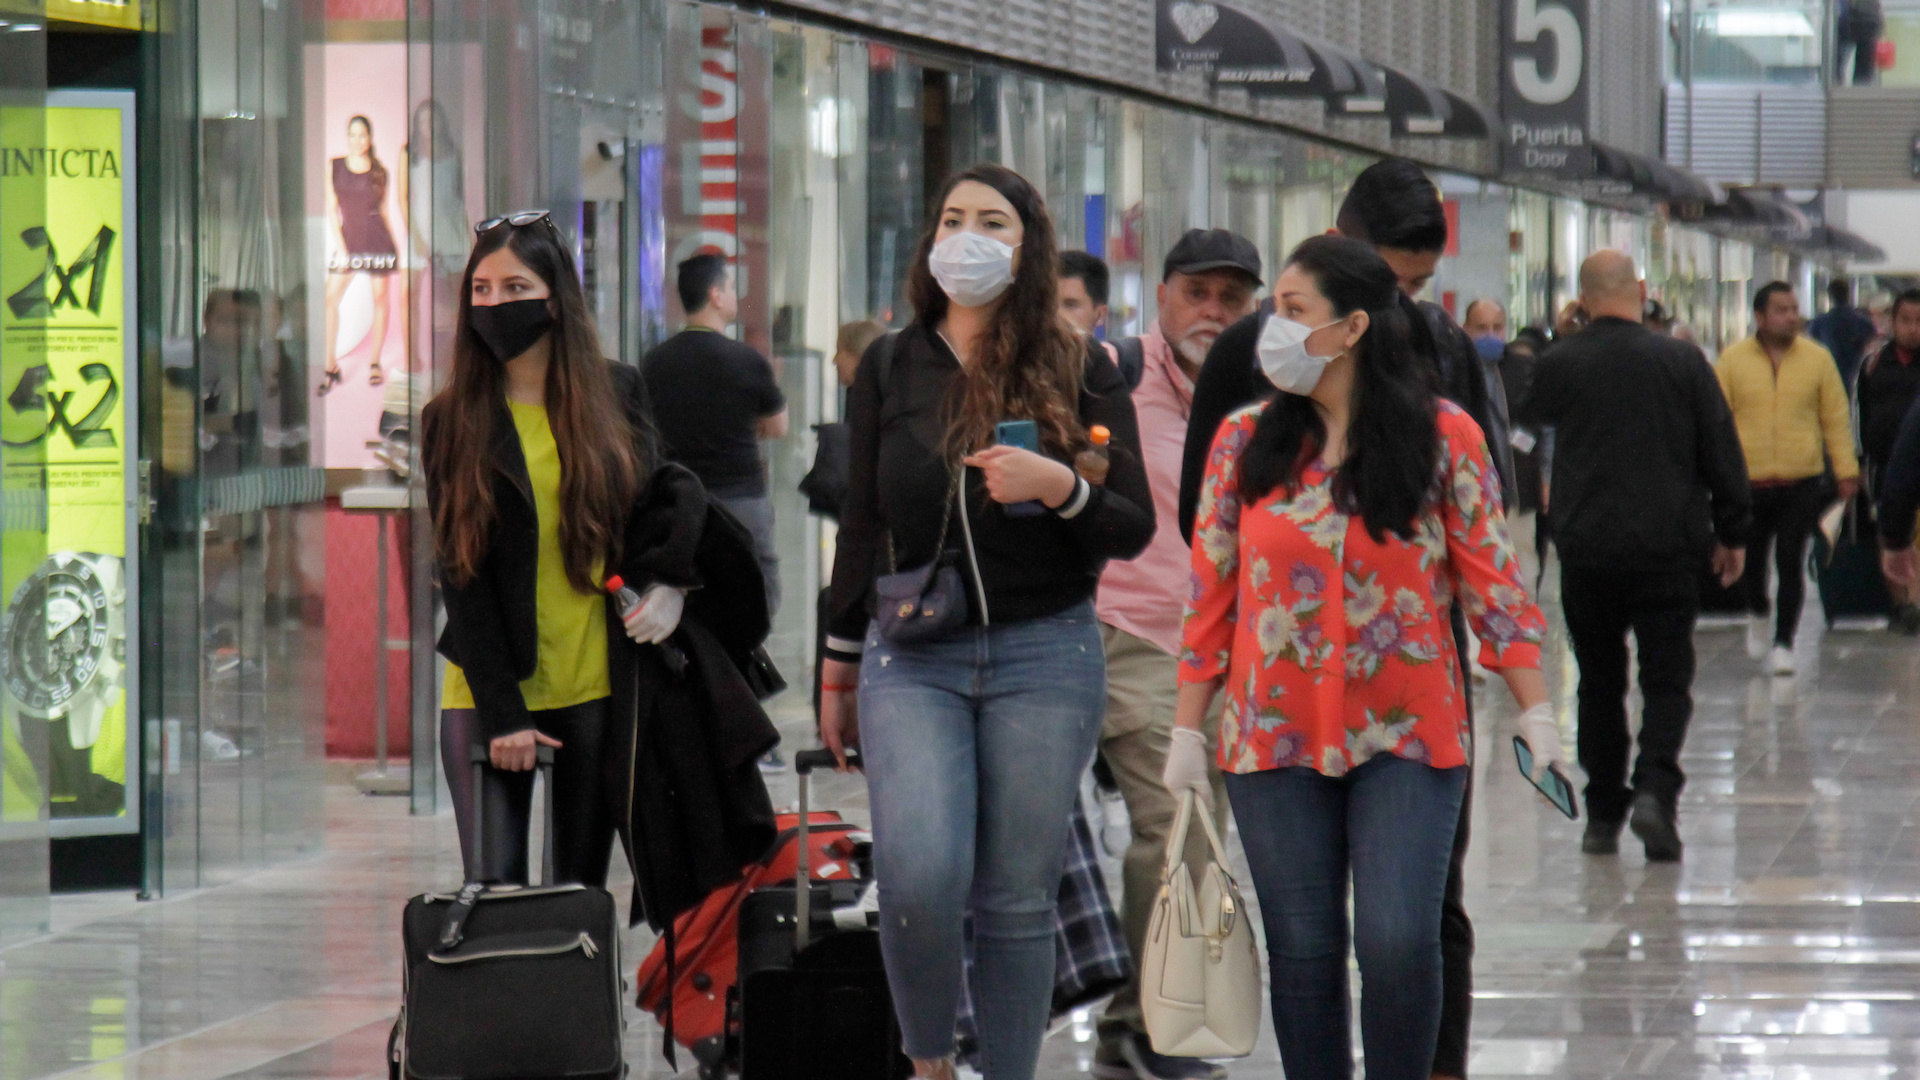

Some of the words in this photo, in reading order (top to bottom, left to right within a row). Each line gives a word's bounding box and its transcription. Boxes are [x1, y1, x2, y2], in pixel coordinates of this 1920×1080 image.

[1513, 0, 1583, 105] 5
[1511, 121, 1584, 146] Puerta
[1525, 148, 1569, 169] Door
